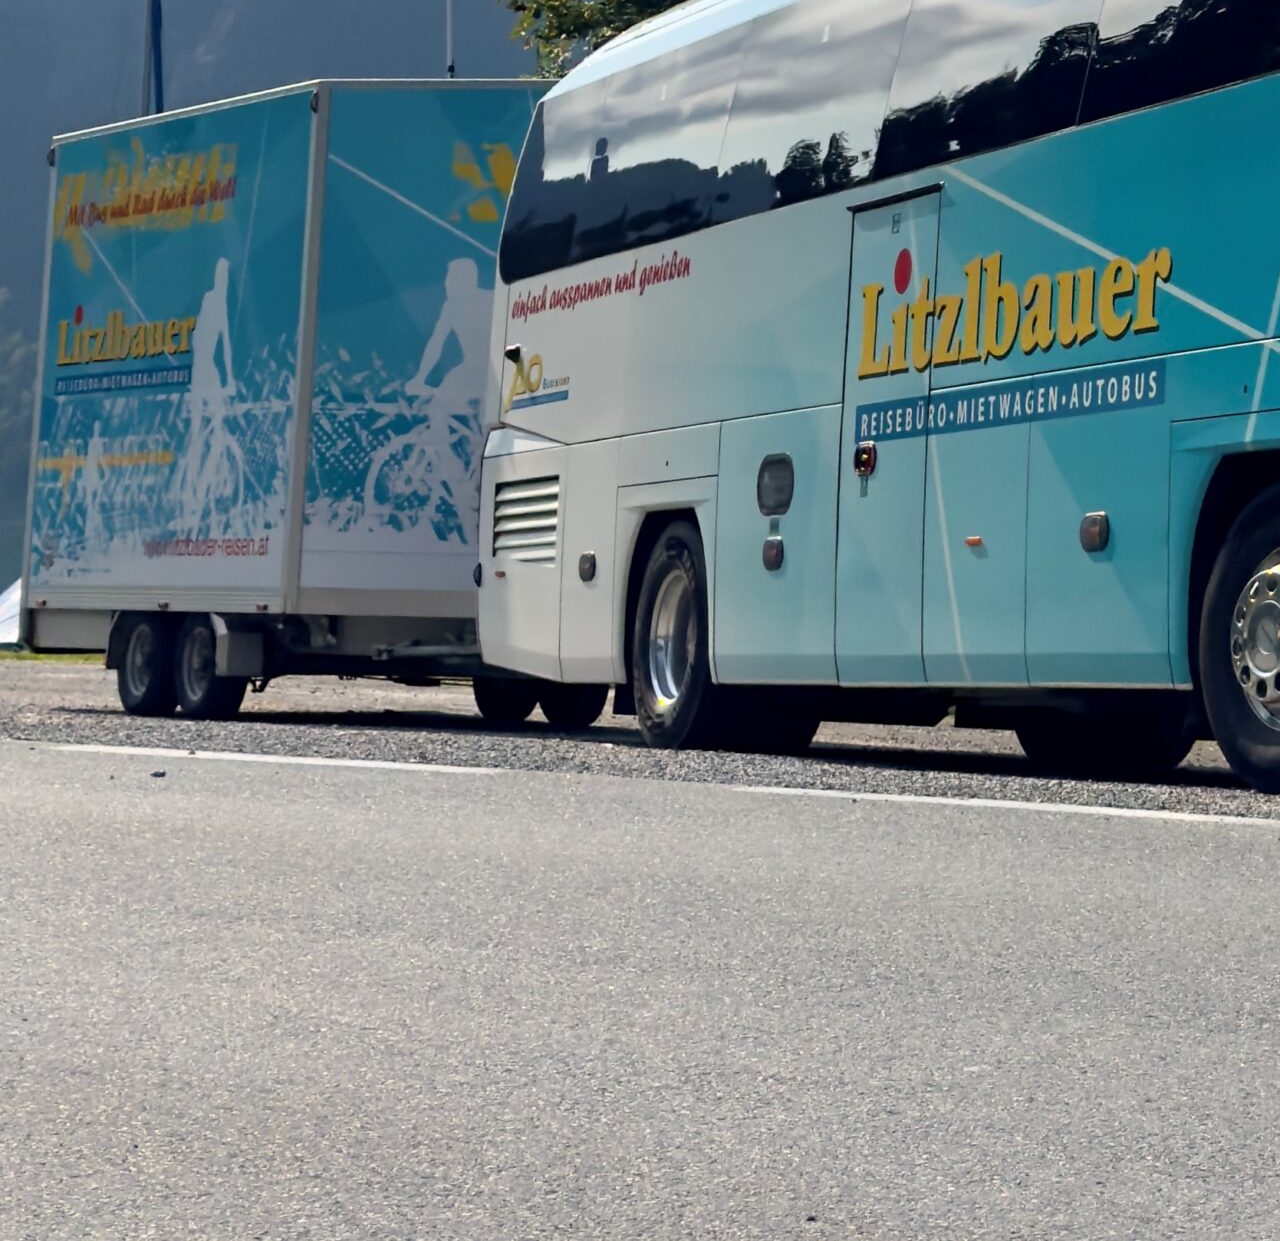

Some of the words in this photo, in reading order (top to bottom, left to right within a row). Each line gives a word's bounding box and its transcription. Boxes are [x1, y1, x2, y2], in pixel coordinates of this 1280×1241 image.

[511, 284, 548, 323] einfach
[549, 276, 612, 310] ausspannen
[614, 259, 637, 294] und
[639, 250, 691, 296] genießen
[858, 248, 1173, 380] Litzlbauer
[56, 304, 197, 367] Litzlbauer
